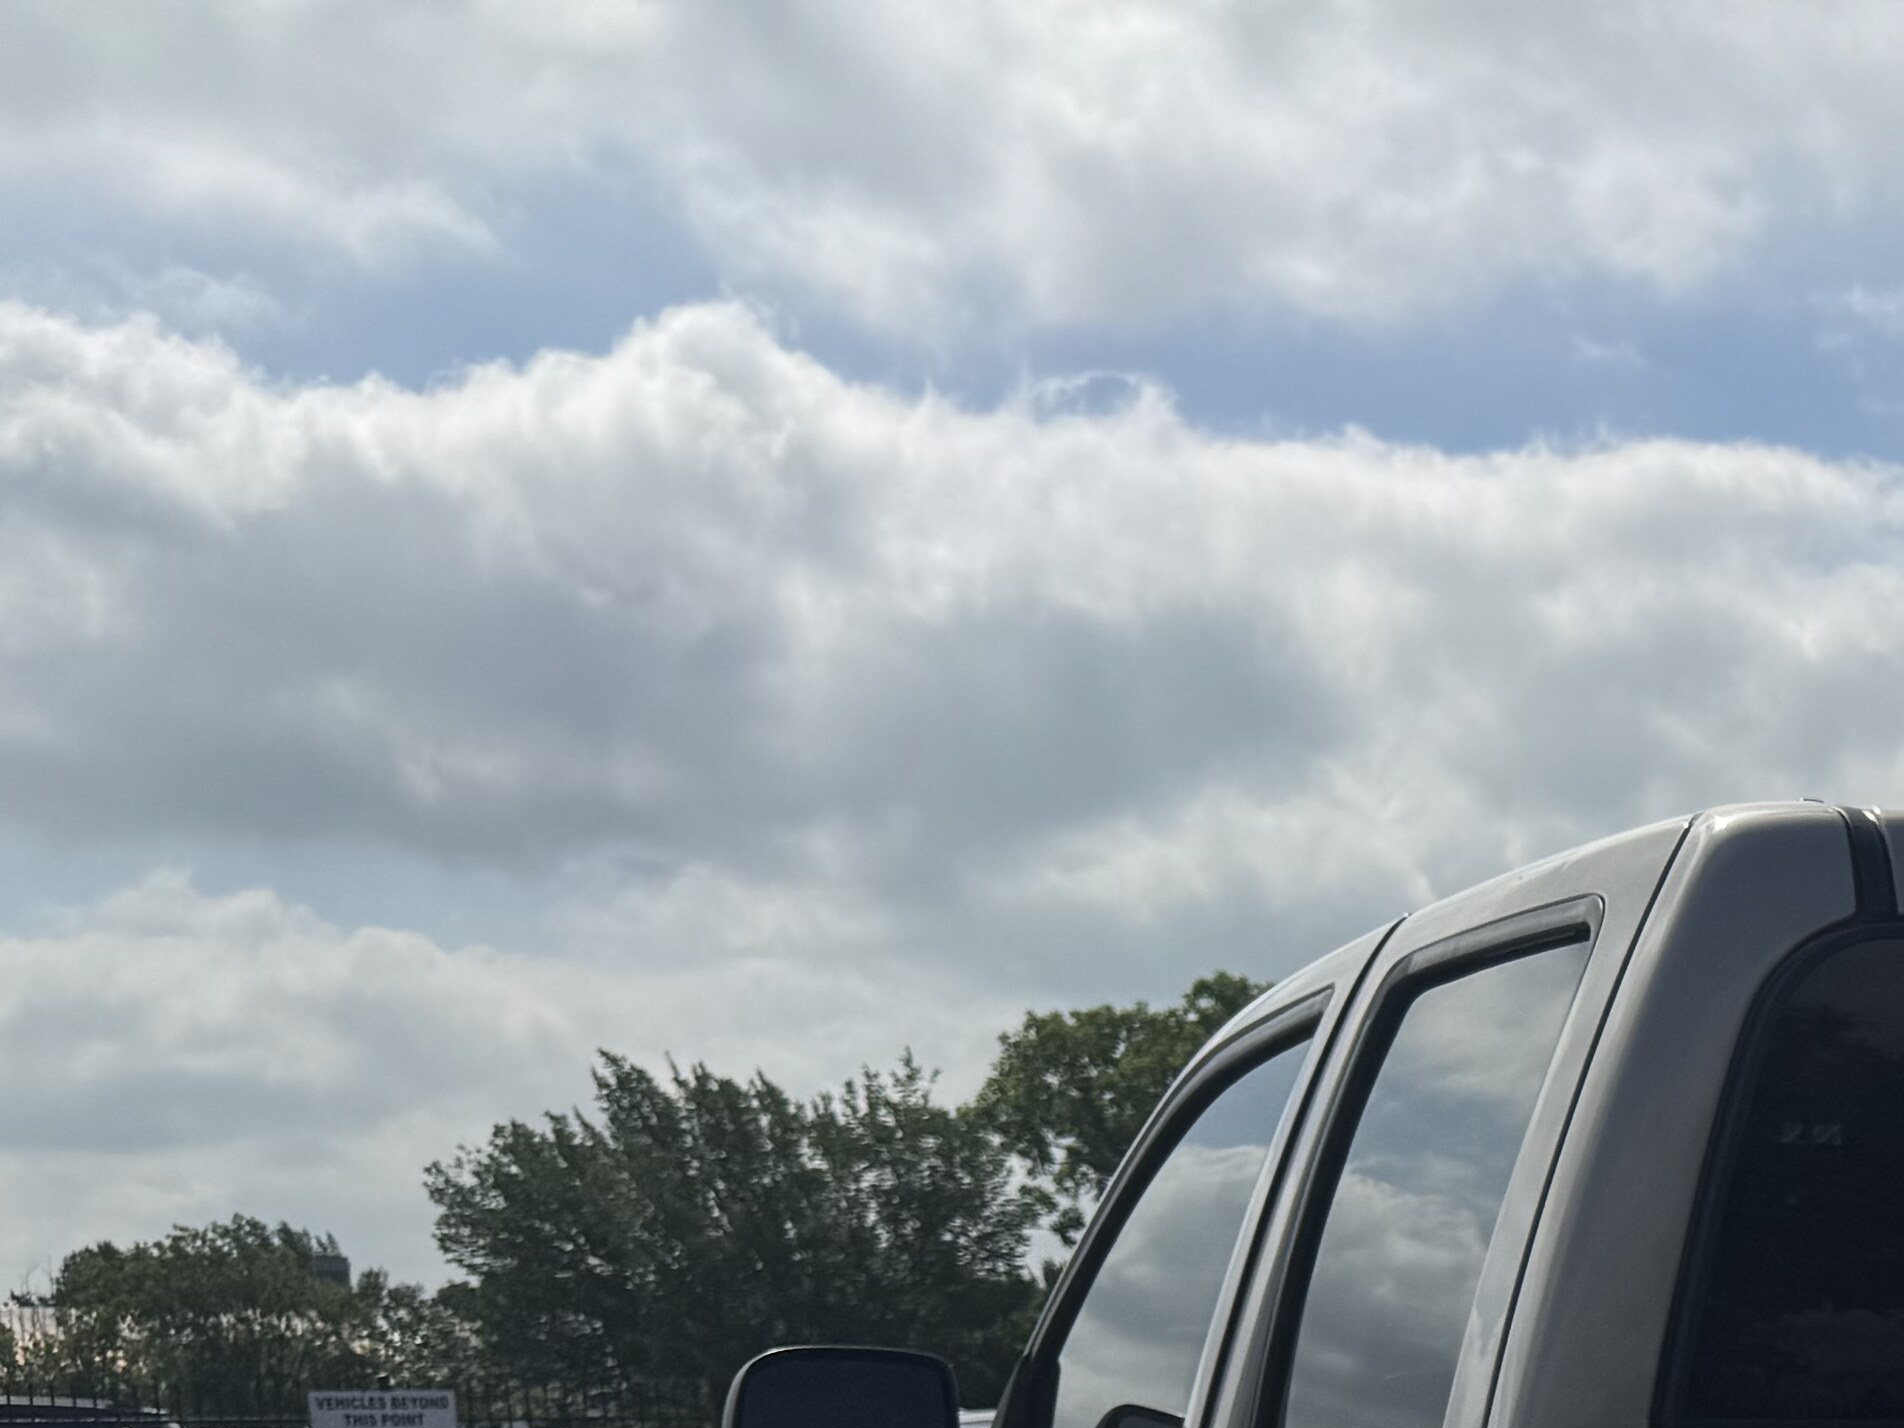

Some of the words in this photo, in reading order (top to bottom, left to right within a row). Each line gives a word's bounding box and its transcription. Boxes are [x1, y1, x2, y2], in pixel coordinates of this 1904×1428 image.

[315, 1396, 386, 1410] VEHICLES
[391, 1395, 449, 1410] BEYOND
[344, 1413, 378, 1427] THIS
[382, 1413, 424, 1427] POINT
